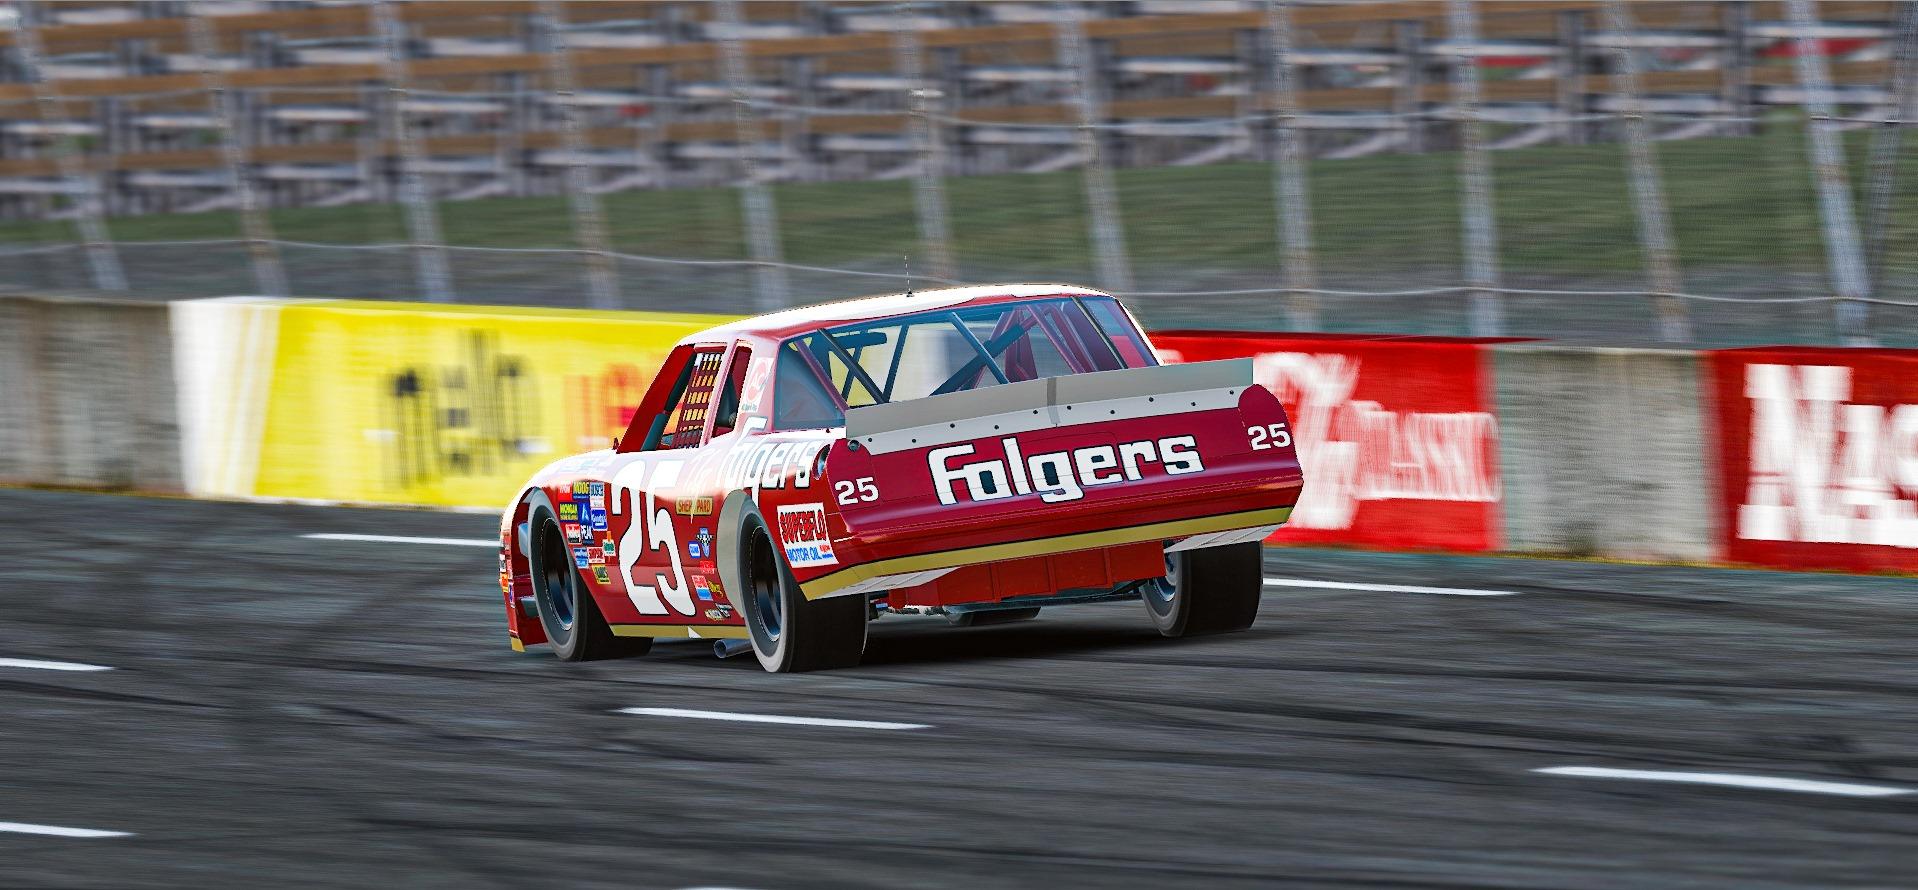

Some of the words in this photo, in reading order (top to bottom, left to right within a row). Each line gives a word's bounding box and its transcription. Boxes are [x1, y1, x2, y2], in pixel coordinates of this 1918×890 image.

[1247, 422, 1291, 451] 25
[926, 436, 1206, 505] Folgers
[834, 476, 879, 506] 25
[610, 459, 697, 617] 25
[786, 546, 809, 563] MOTOR
[809, 546, 822, 561] OIL
